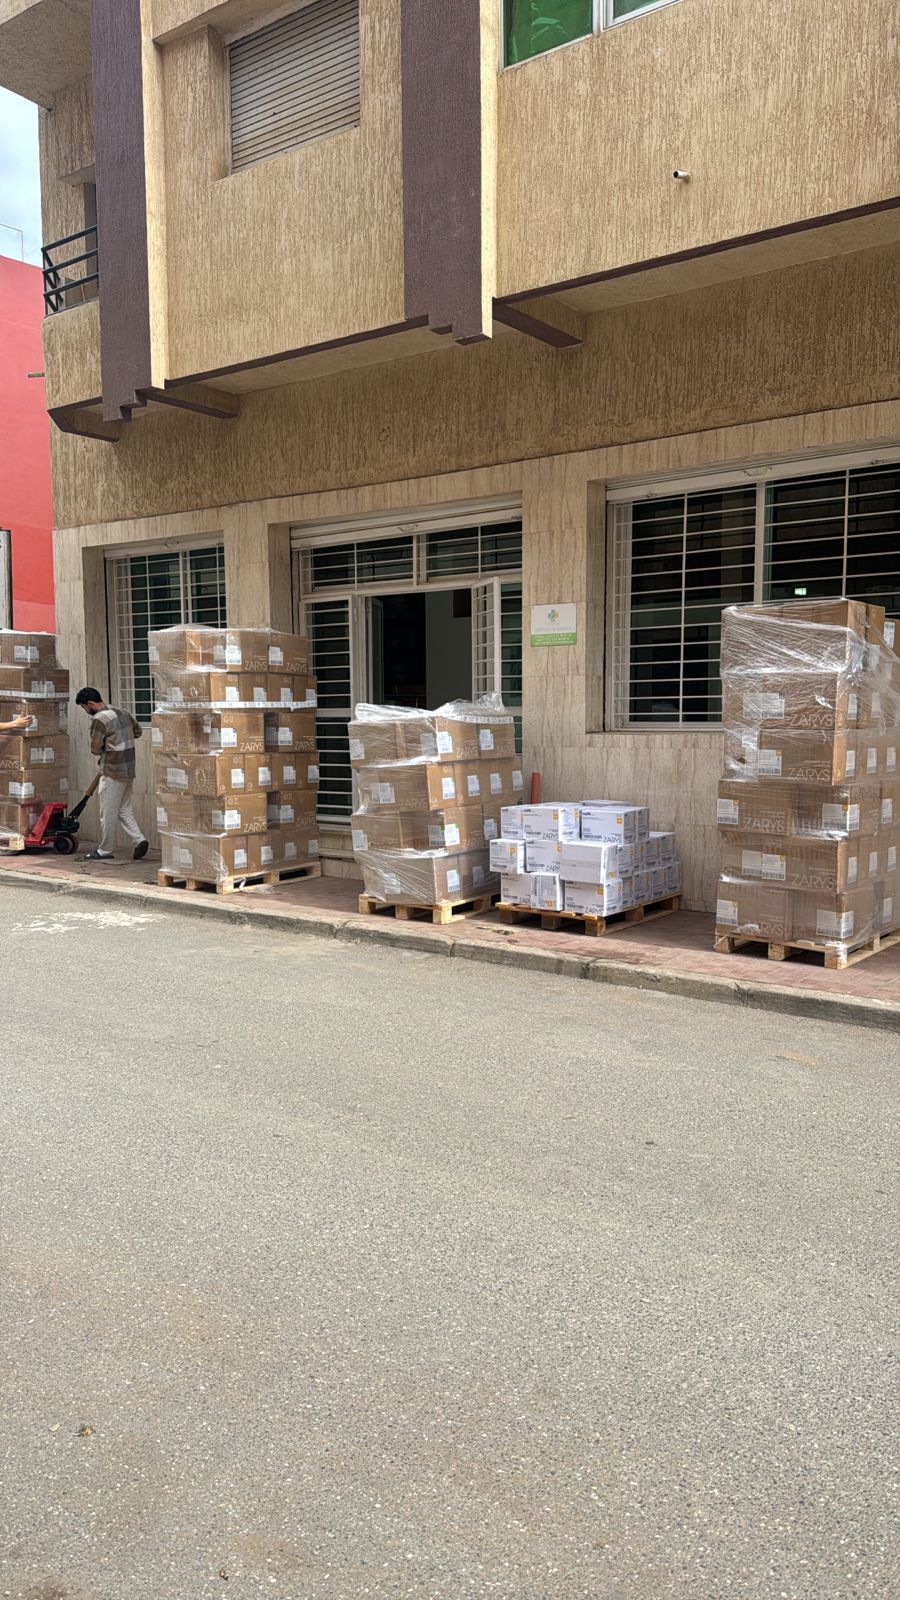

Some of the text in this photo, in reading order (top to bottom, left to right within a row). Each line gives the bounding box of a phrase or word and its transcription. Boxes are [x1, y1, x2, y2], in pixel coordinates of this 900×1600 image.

[286, 663, 307, 673] ZARYS
[240, 742, 264, 752] ZARYS
[0, 759, 20, 769] ARYS
[788, 767, 831, 782] ZARYS
[243, 822, 268, 833] ZARYS
[744, 817, 784, 833] ZARYS
[791, 874, 837, 889] ZARYS
[760, 921, 785, 936] RYS
